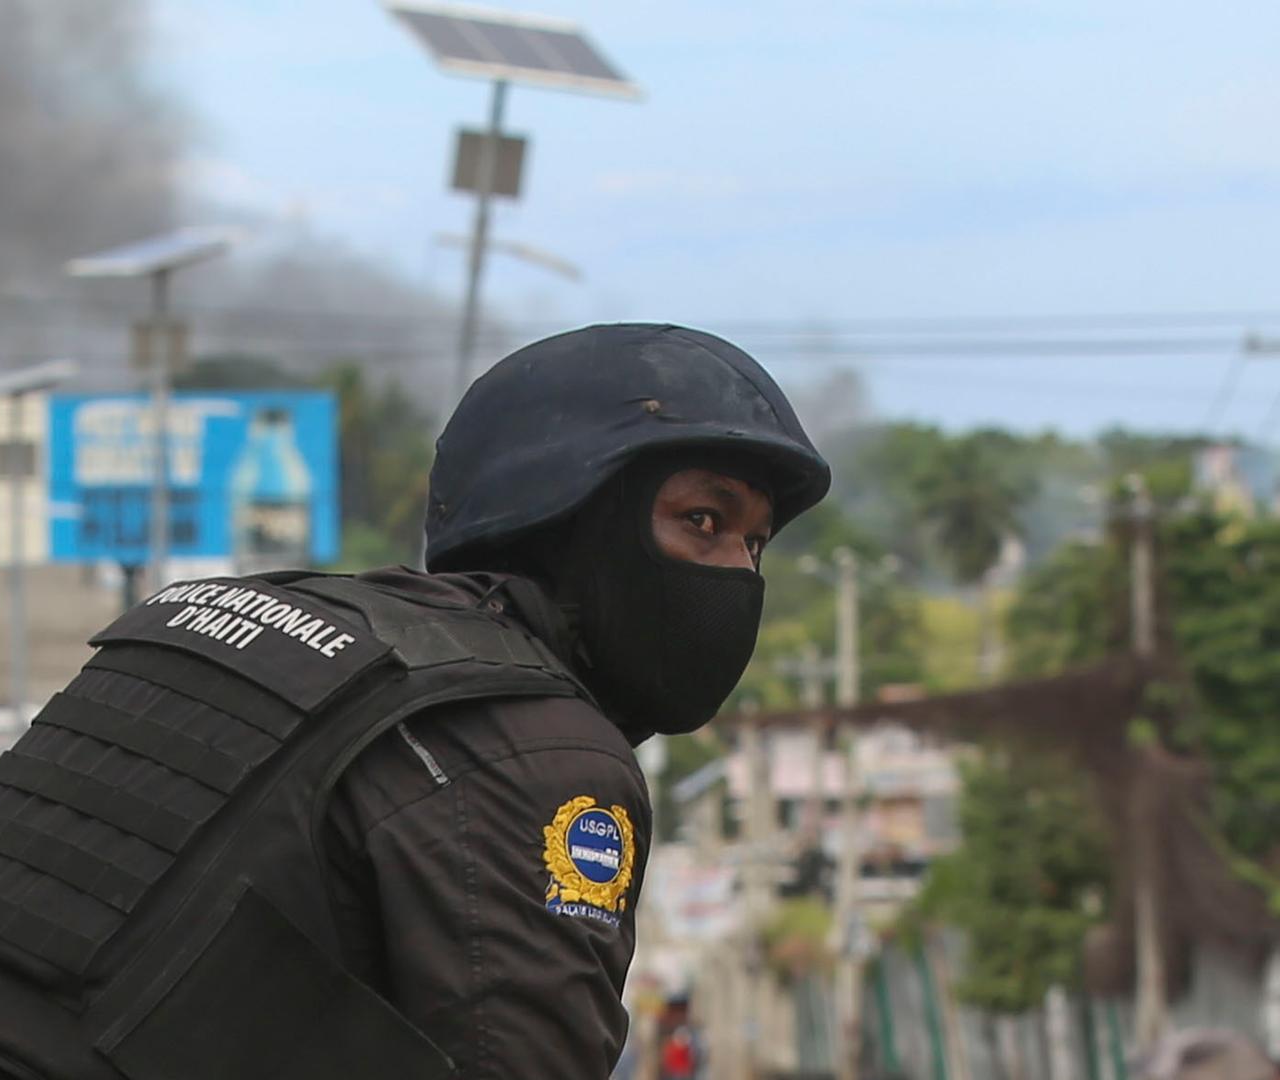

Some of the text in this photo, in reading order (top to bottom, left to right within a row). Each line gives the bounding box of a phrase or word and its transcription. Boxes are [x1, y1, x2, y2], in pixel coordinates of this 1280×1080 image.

[147, 583, 356, 658] POLICE NATIONALE
[166, 606, 265, 650] D'HAITI
